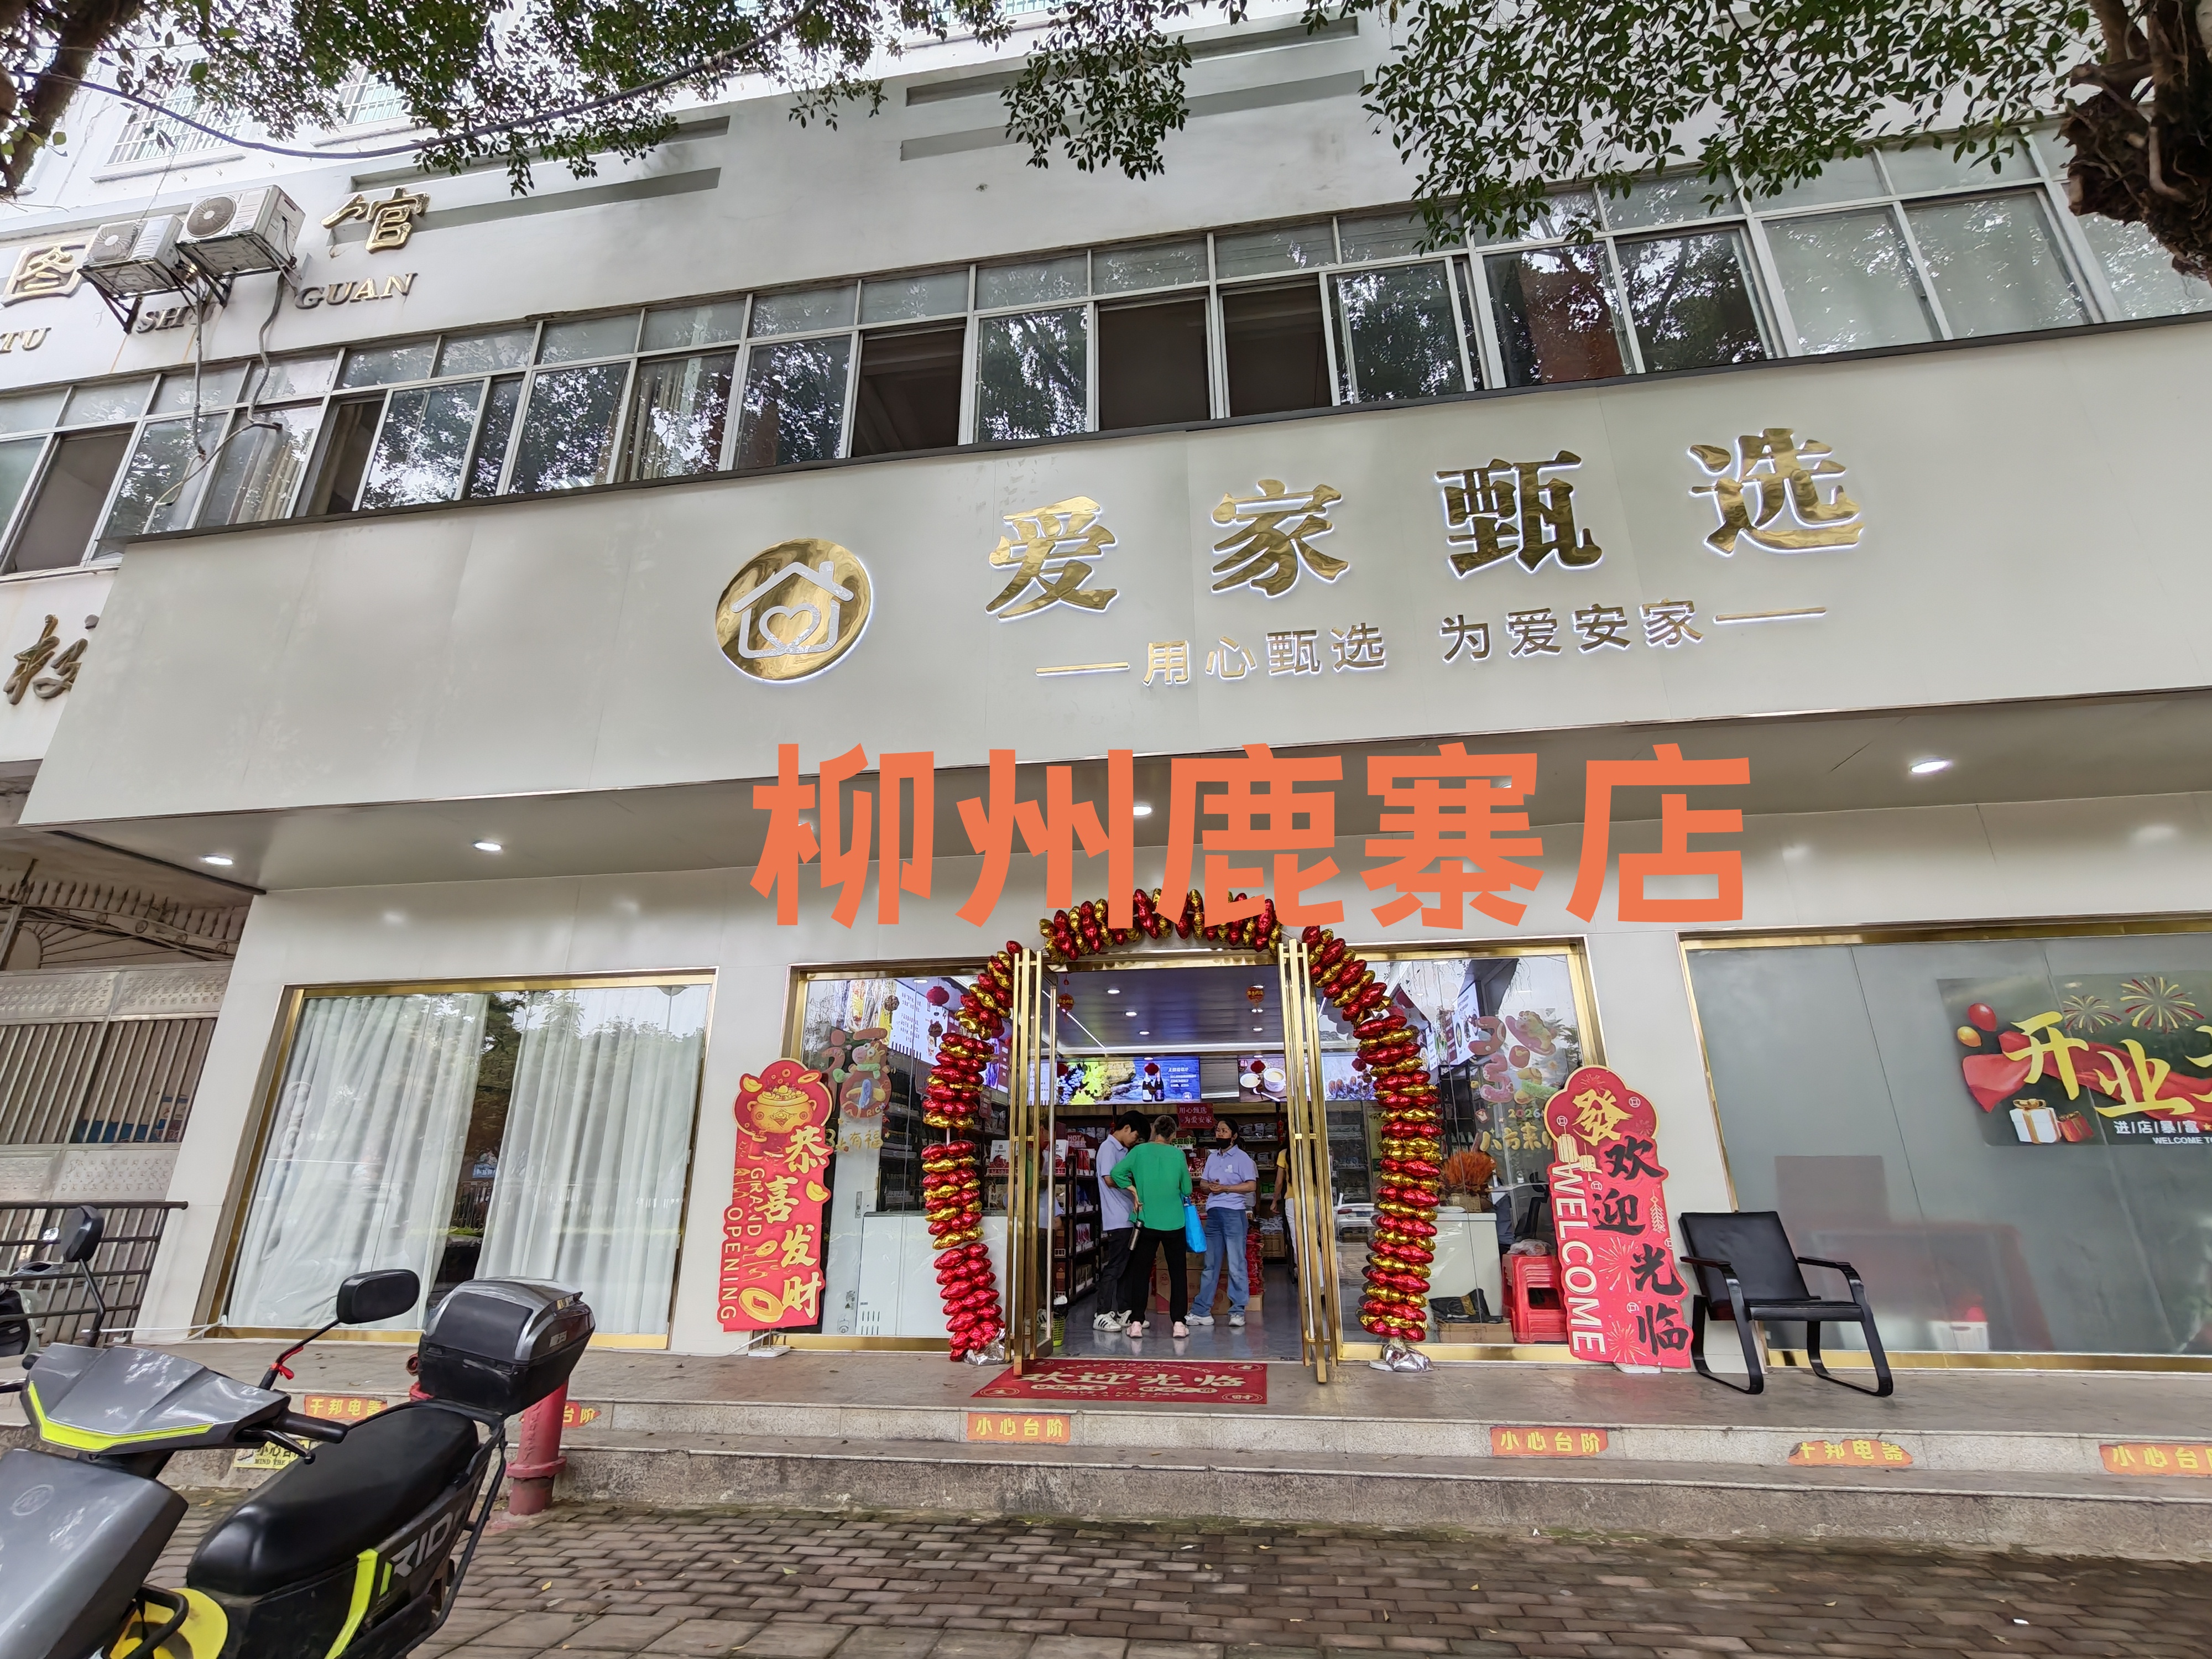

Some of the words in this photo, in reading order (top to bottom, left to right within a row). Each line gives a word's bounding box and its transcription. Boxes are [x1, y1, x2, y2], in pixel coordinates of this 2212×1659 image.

[294, 272, 419, 310] GUAN
[985, 428, 1864, 620] 爱家甄选
[1142, 622, 1387, 686] 用心甄选
[1439, 598, 1704, 662] 为爱安家
[747, 1167, 765, 1237] GRAND
[754, 1124, 832, 1319] 恭喜发财
[1592, 1134, 1691, 1358] 欢迎光临
[721, 1207, 743, 1320] OPENING
[1552, 1162, 1605, 1355] WELCOME
[1011, 1371, 1246, 1387] 欢迎光临
[974, 1416, 1064, 1438] 小心台阶
[1500, 1430, 1601, 1454] 小心台阶
